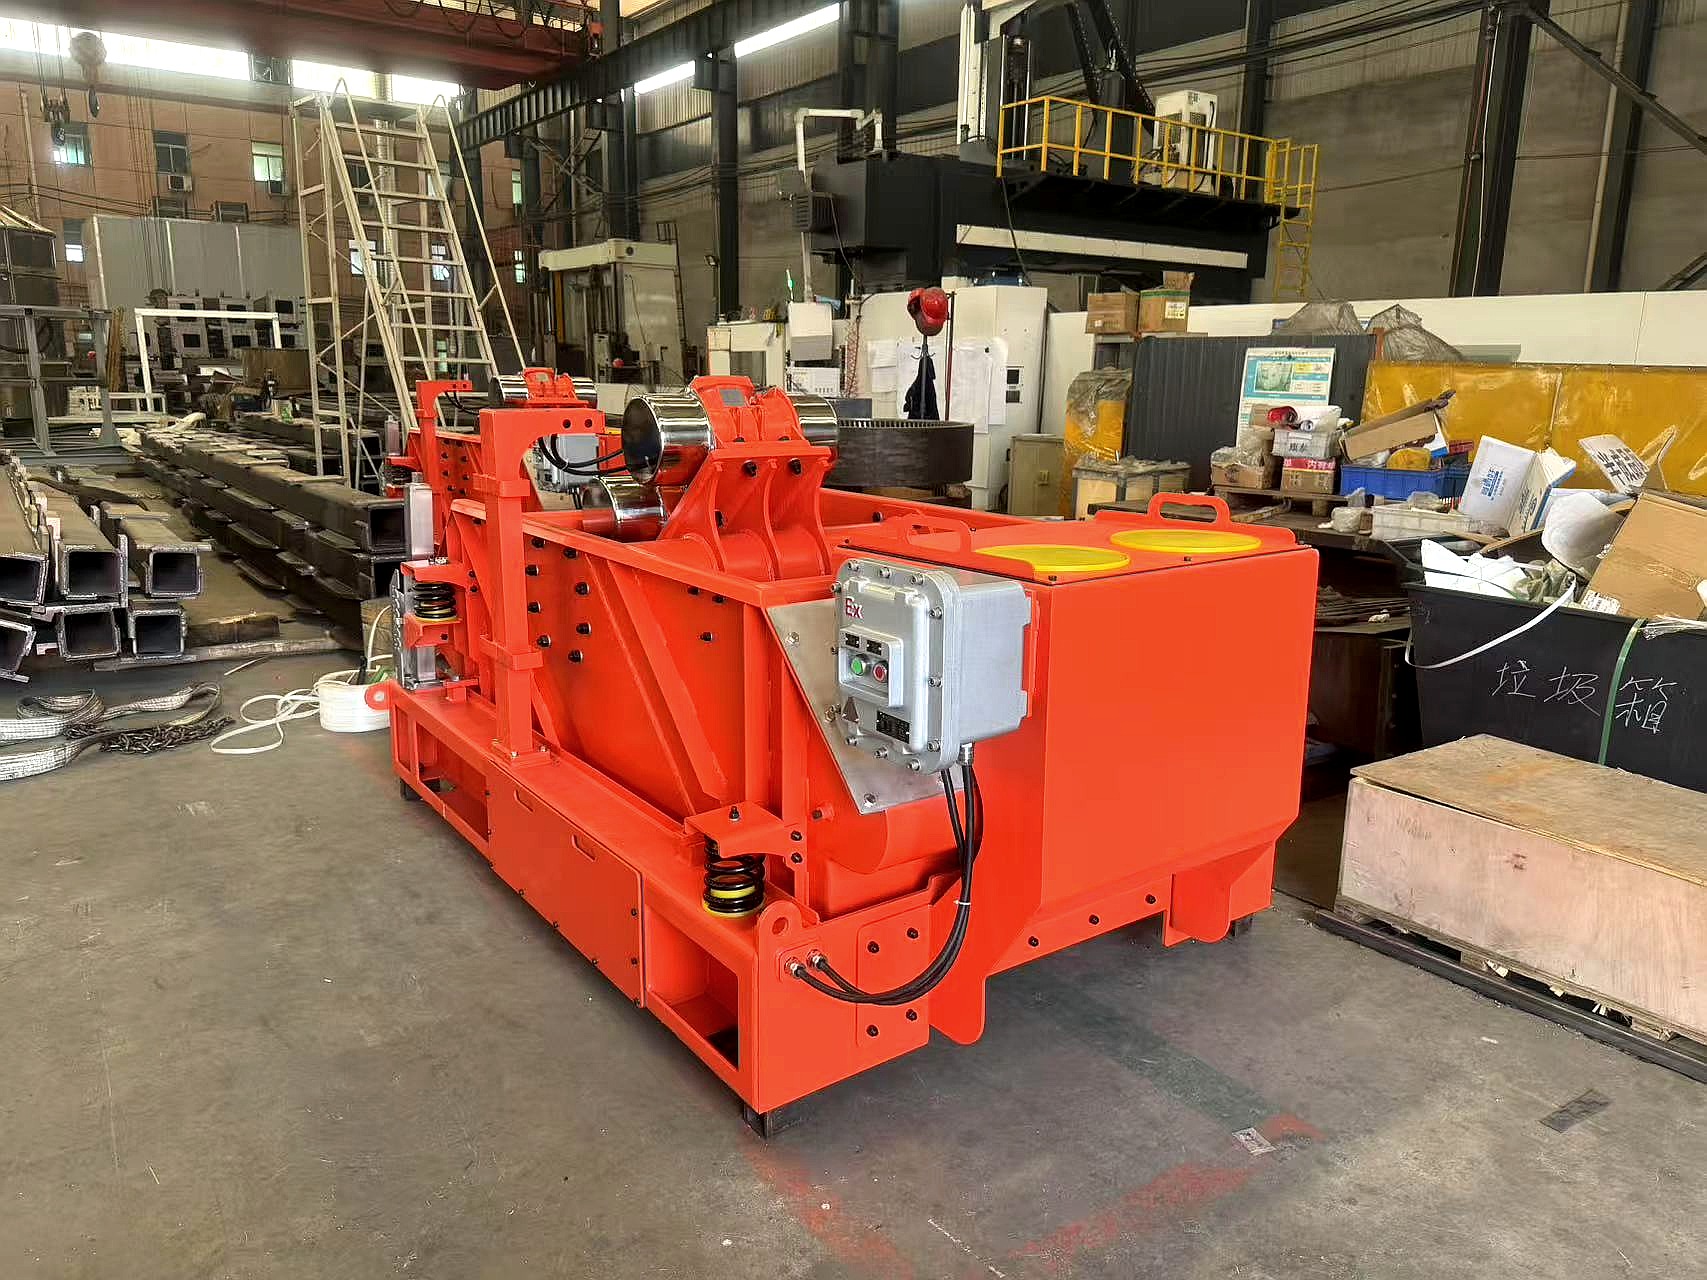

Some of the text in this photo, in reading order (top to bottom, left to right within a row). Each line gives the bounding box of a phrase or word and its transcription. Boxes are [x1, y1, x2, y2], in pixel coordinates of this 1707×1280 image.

[845, 596, 864, 619] Ex
[1489, 659, 1678, 734] 垃圾箱
